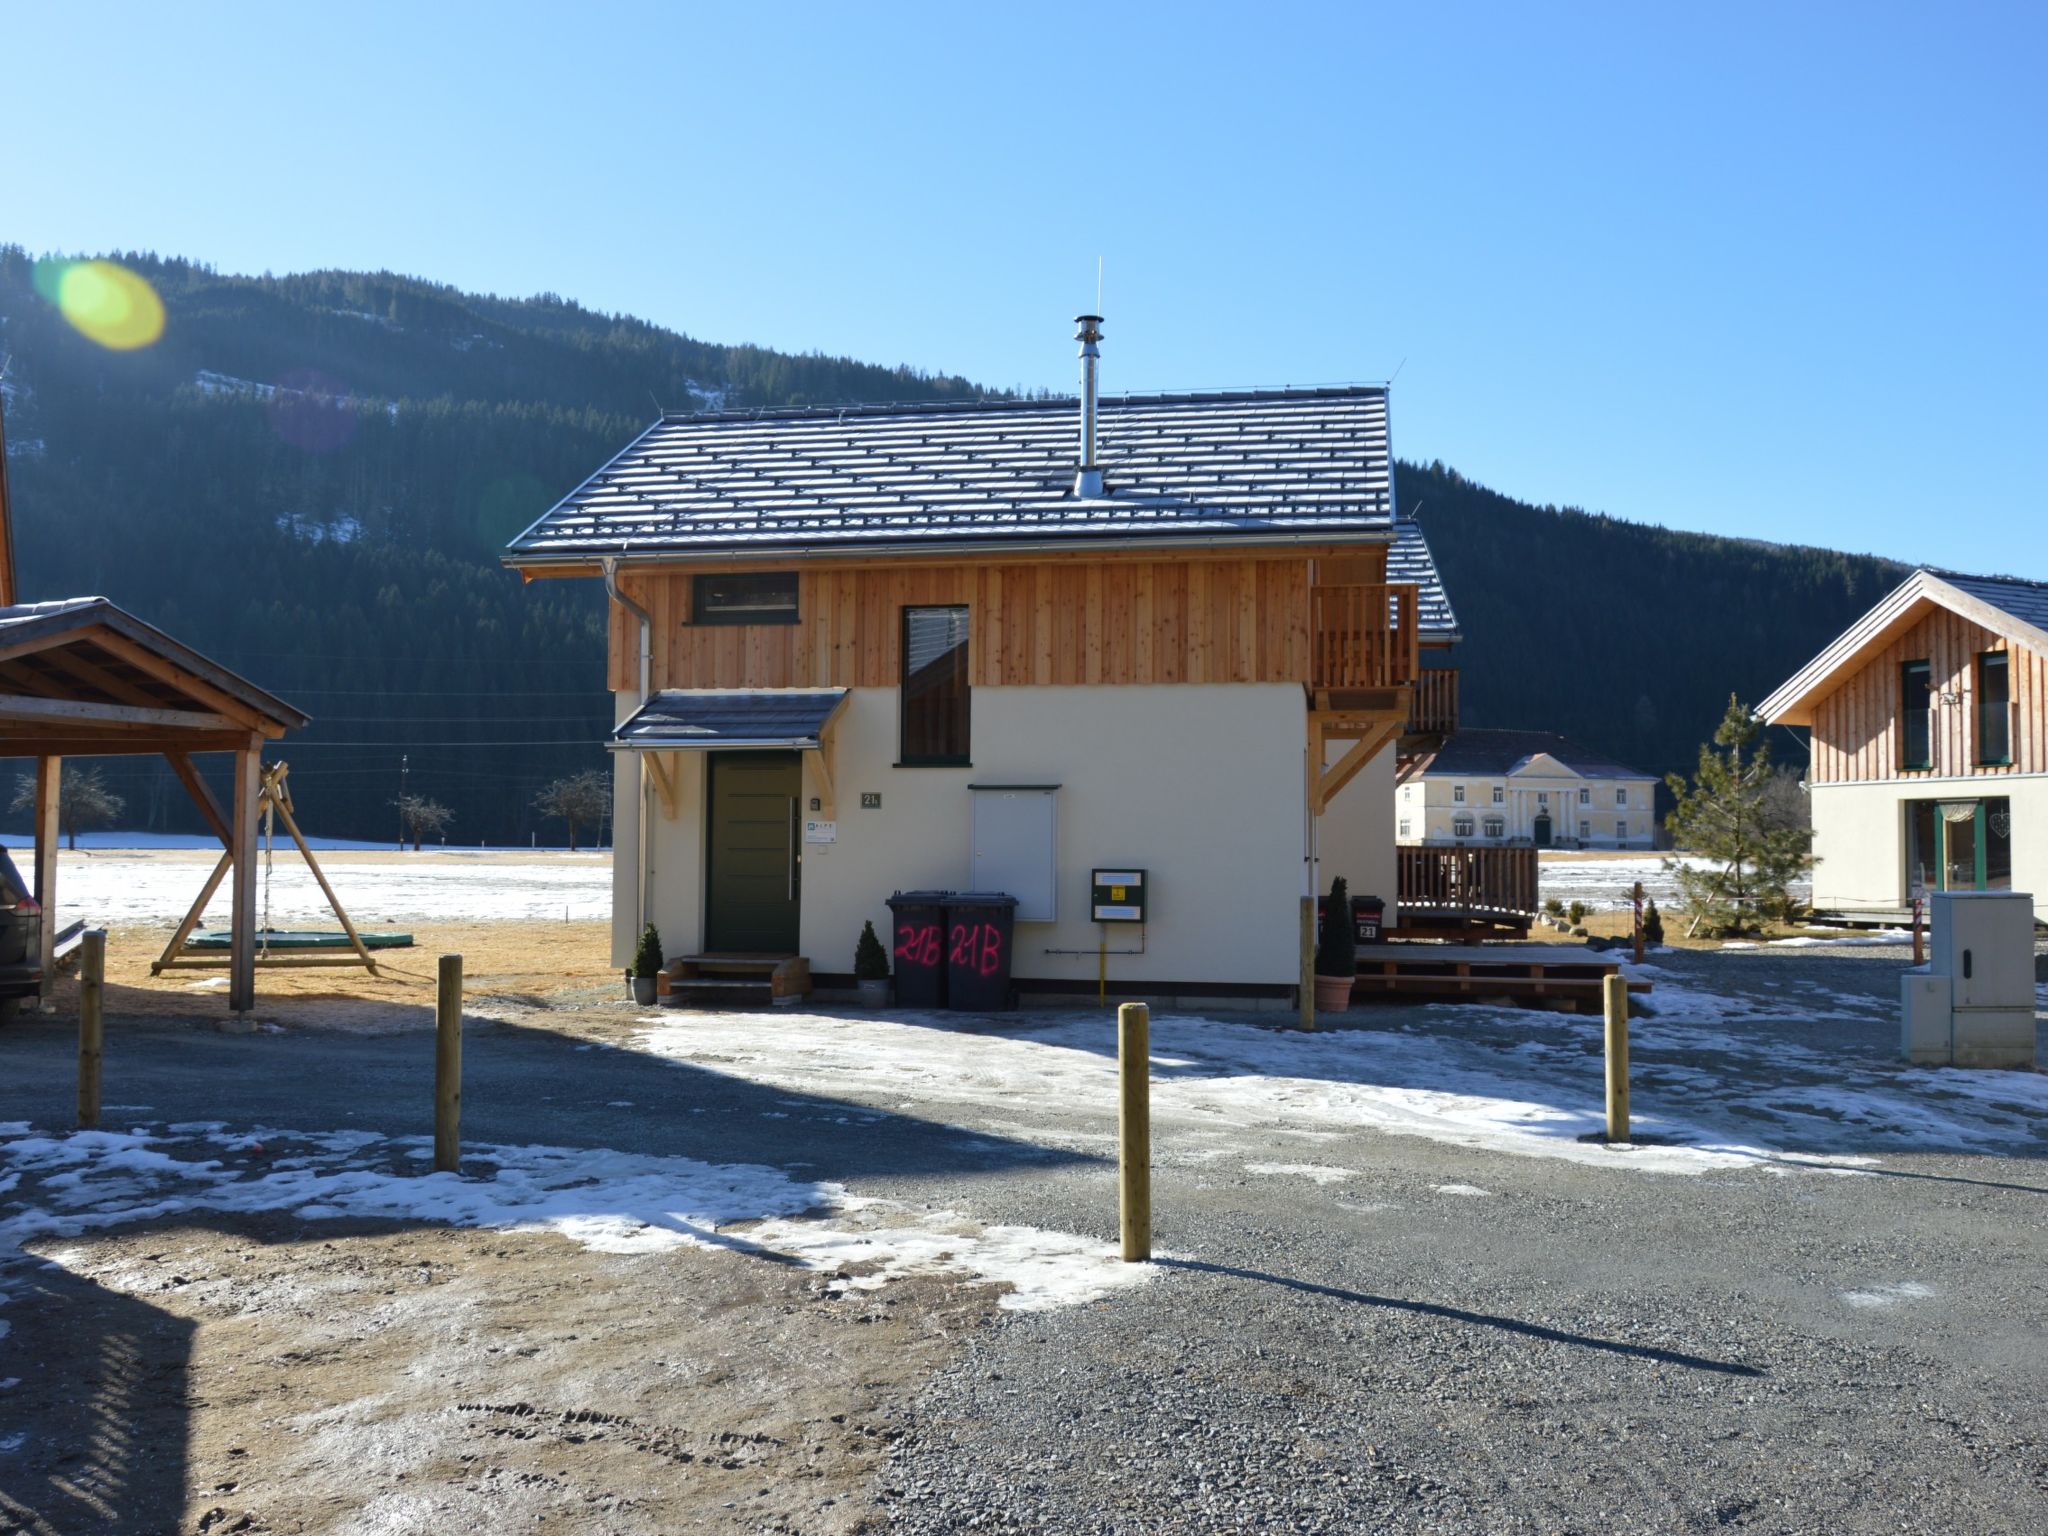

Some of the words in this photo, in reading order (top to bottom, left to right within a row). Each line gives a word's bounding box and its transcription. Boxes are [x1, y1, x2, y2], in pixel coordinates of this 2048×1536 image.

[896, 925, 941, 967] 21B
[950, 923, 1002, 976] 21B
[1361, 927, 1374, 937] 21
